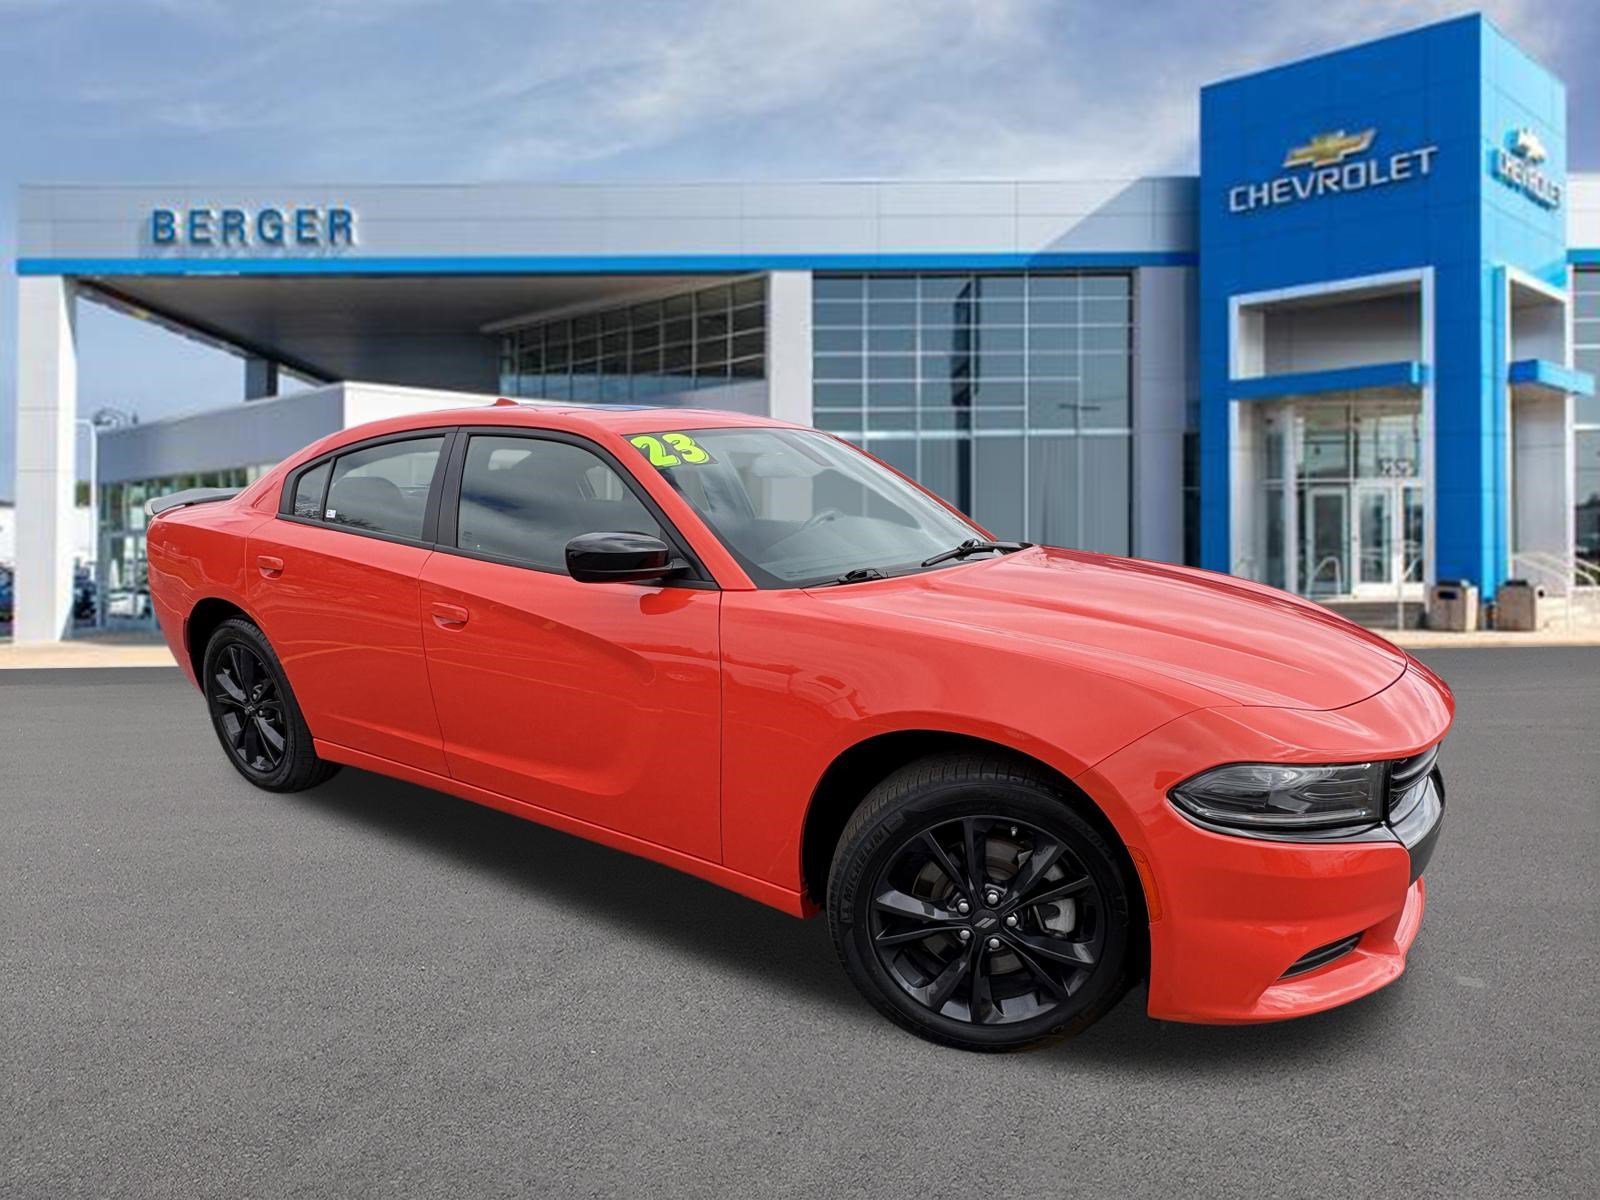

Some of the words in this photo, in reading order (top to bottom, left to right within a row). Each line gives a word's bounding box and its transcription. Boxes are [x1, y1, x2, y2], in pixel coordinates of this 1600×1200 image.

[1229, 146, 1438, 213] CHEVROLET
[152, 208, 356, 246] BERGER
[630, 433, 711, 468] 23
